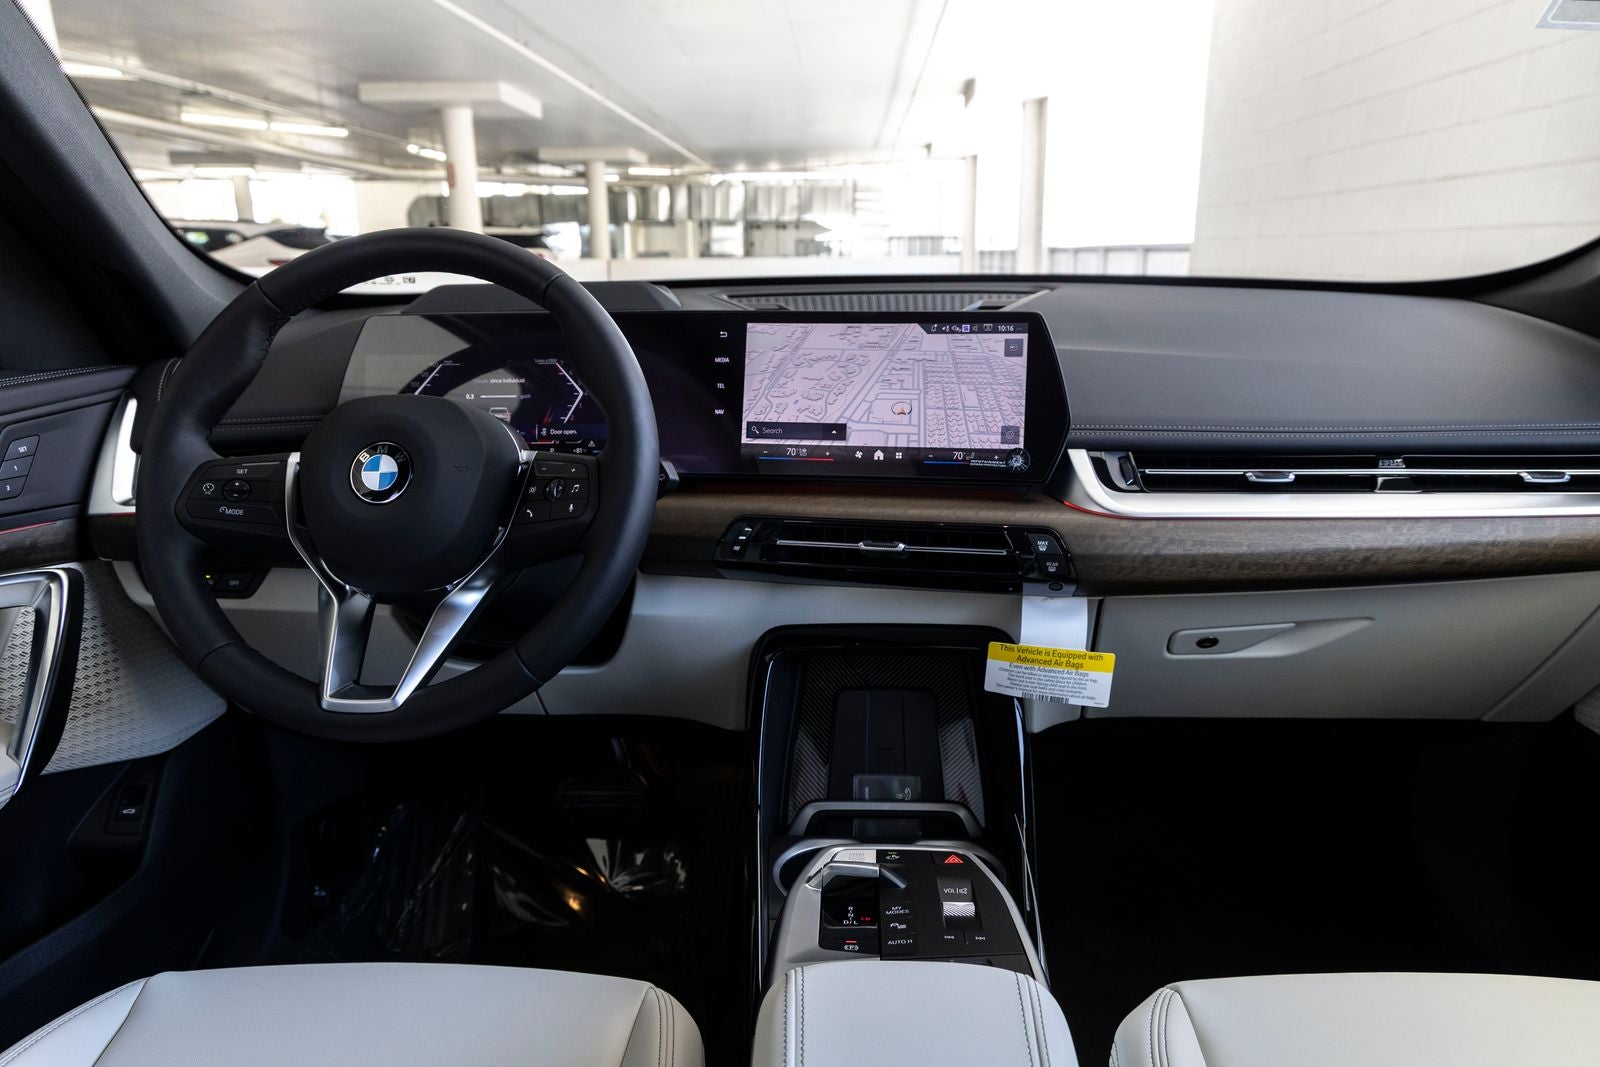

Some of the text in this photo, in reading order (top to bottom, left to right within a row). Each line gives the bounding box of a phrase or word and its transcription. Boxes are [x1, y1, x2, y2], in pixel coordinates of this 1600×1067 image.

[359, 445, 406, 462] BMW
[1000, 644, 1104, 661] This Vehicle is Equipped with
[1016, 654, 1084, 670] Advanced Air Bags
[1037, 666, 1064, 674] Advanced
